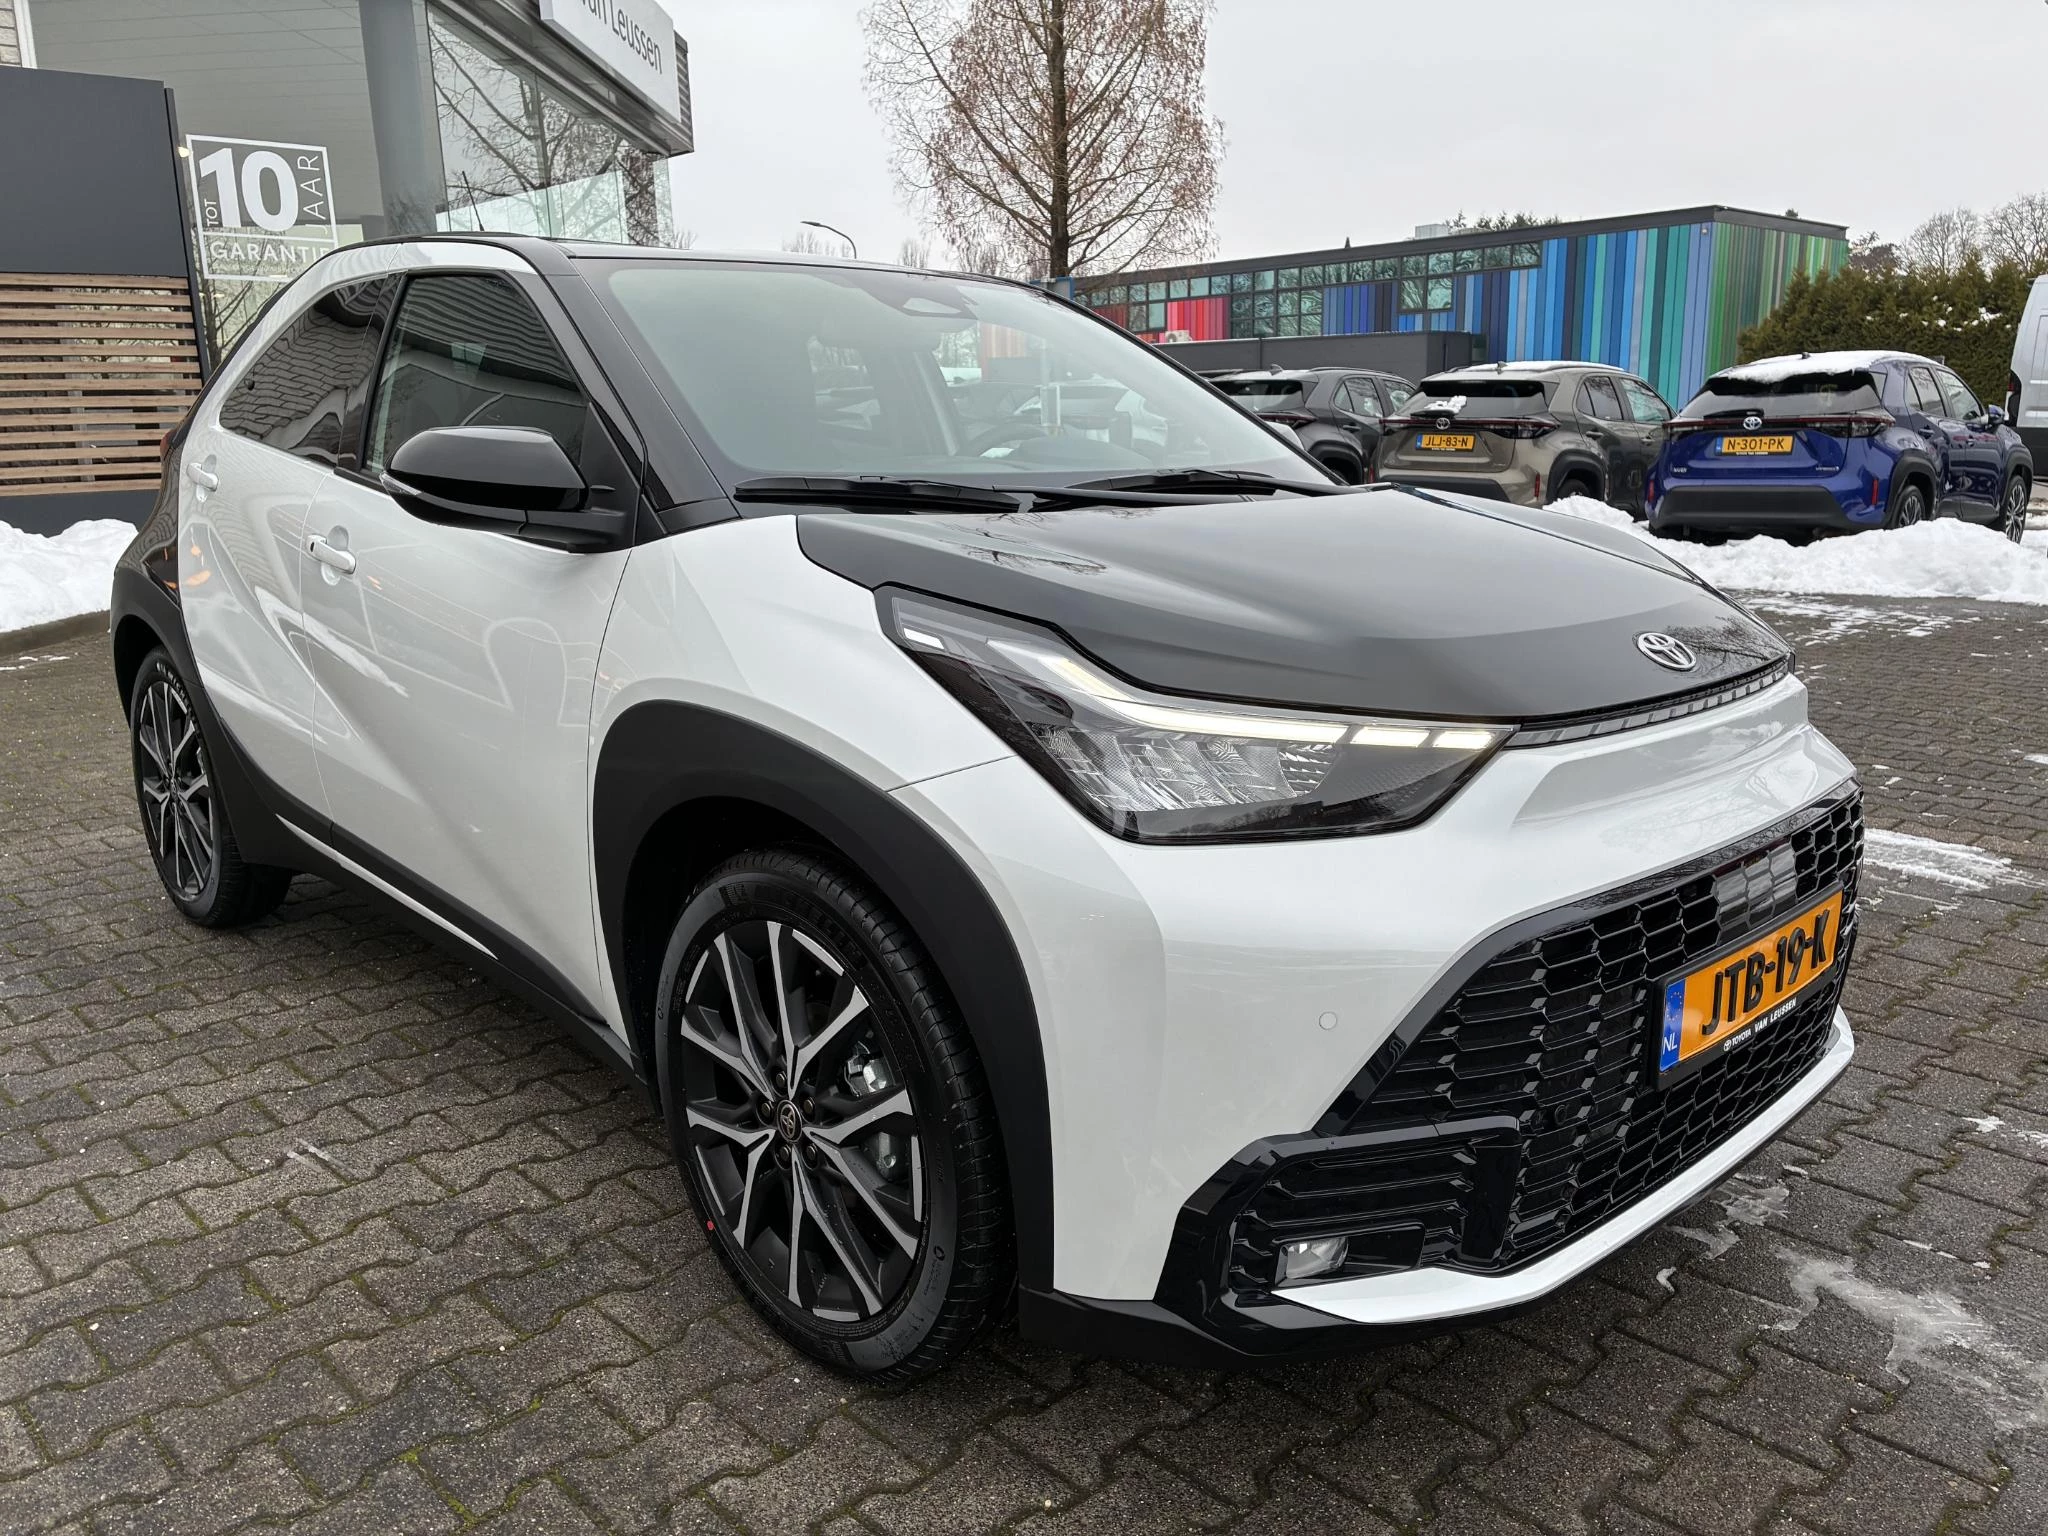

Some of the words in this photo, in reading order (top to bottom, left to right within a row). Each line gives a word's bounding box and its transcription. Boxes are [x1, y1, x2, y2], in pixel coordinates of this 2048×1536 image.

[610, 0, 663, 75] Leussen
[199, 147, 299, 232] 10
[203, 198, 219, 227] TOT
[297, 155, 328, 236] JAAR
[1425, 436, 1469, 447] JLJ-83-N
[1727, 438, 1785, 450] N-301-PK
[1701, 909, 1830, 1036] JTB-19-K
[1662, 1031, 1678, 1055] NL
[1731, 1028, 1752, 1047] TOYOTA
[1754, 1016, 1769, 1033] VAN
[1769, 997, 1797, 1023] LEUSSEN
